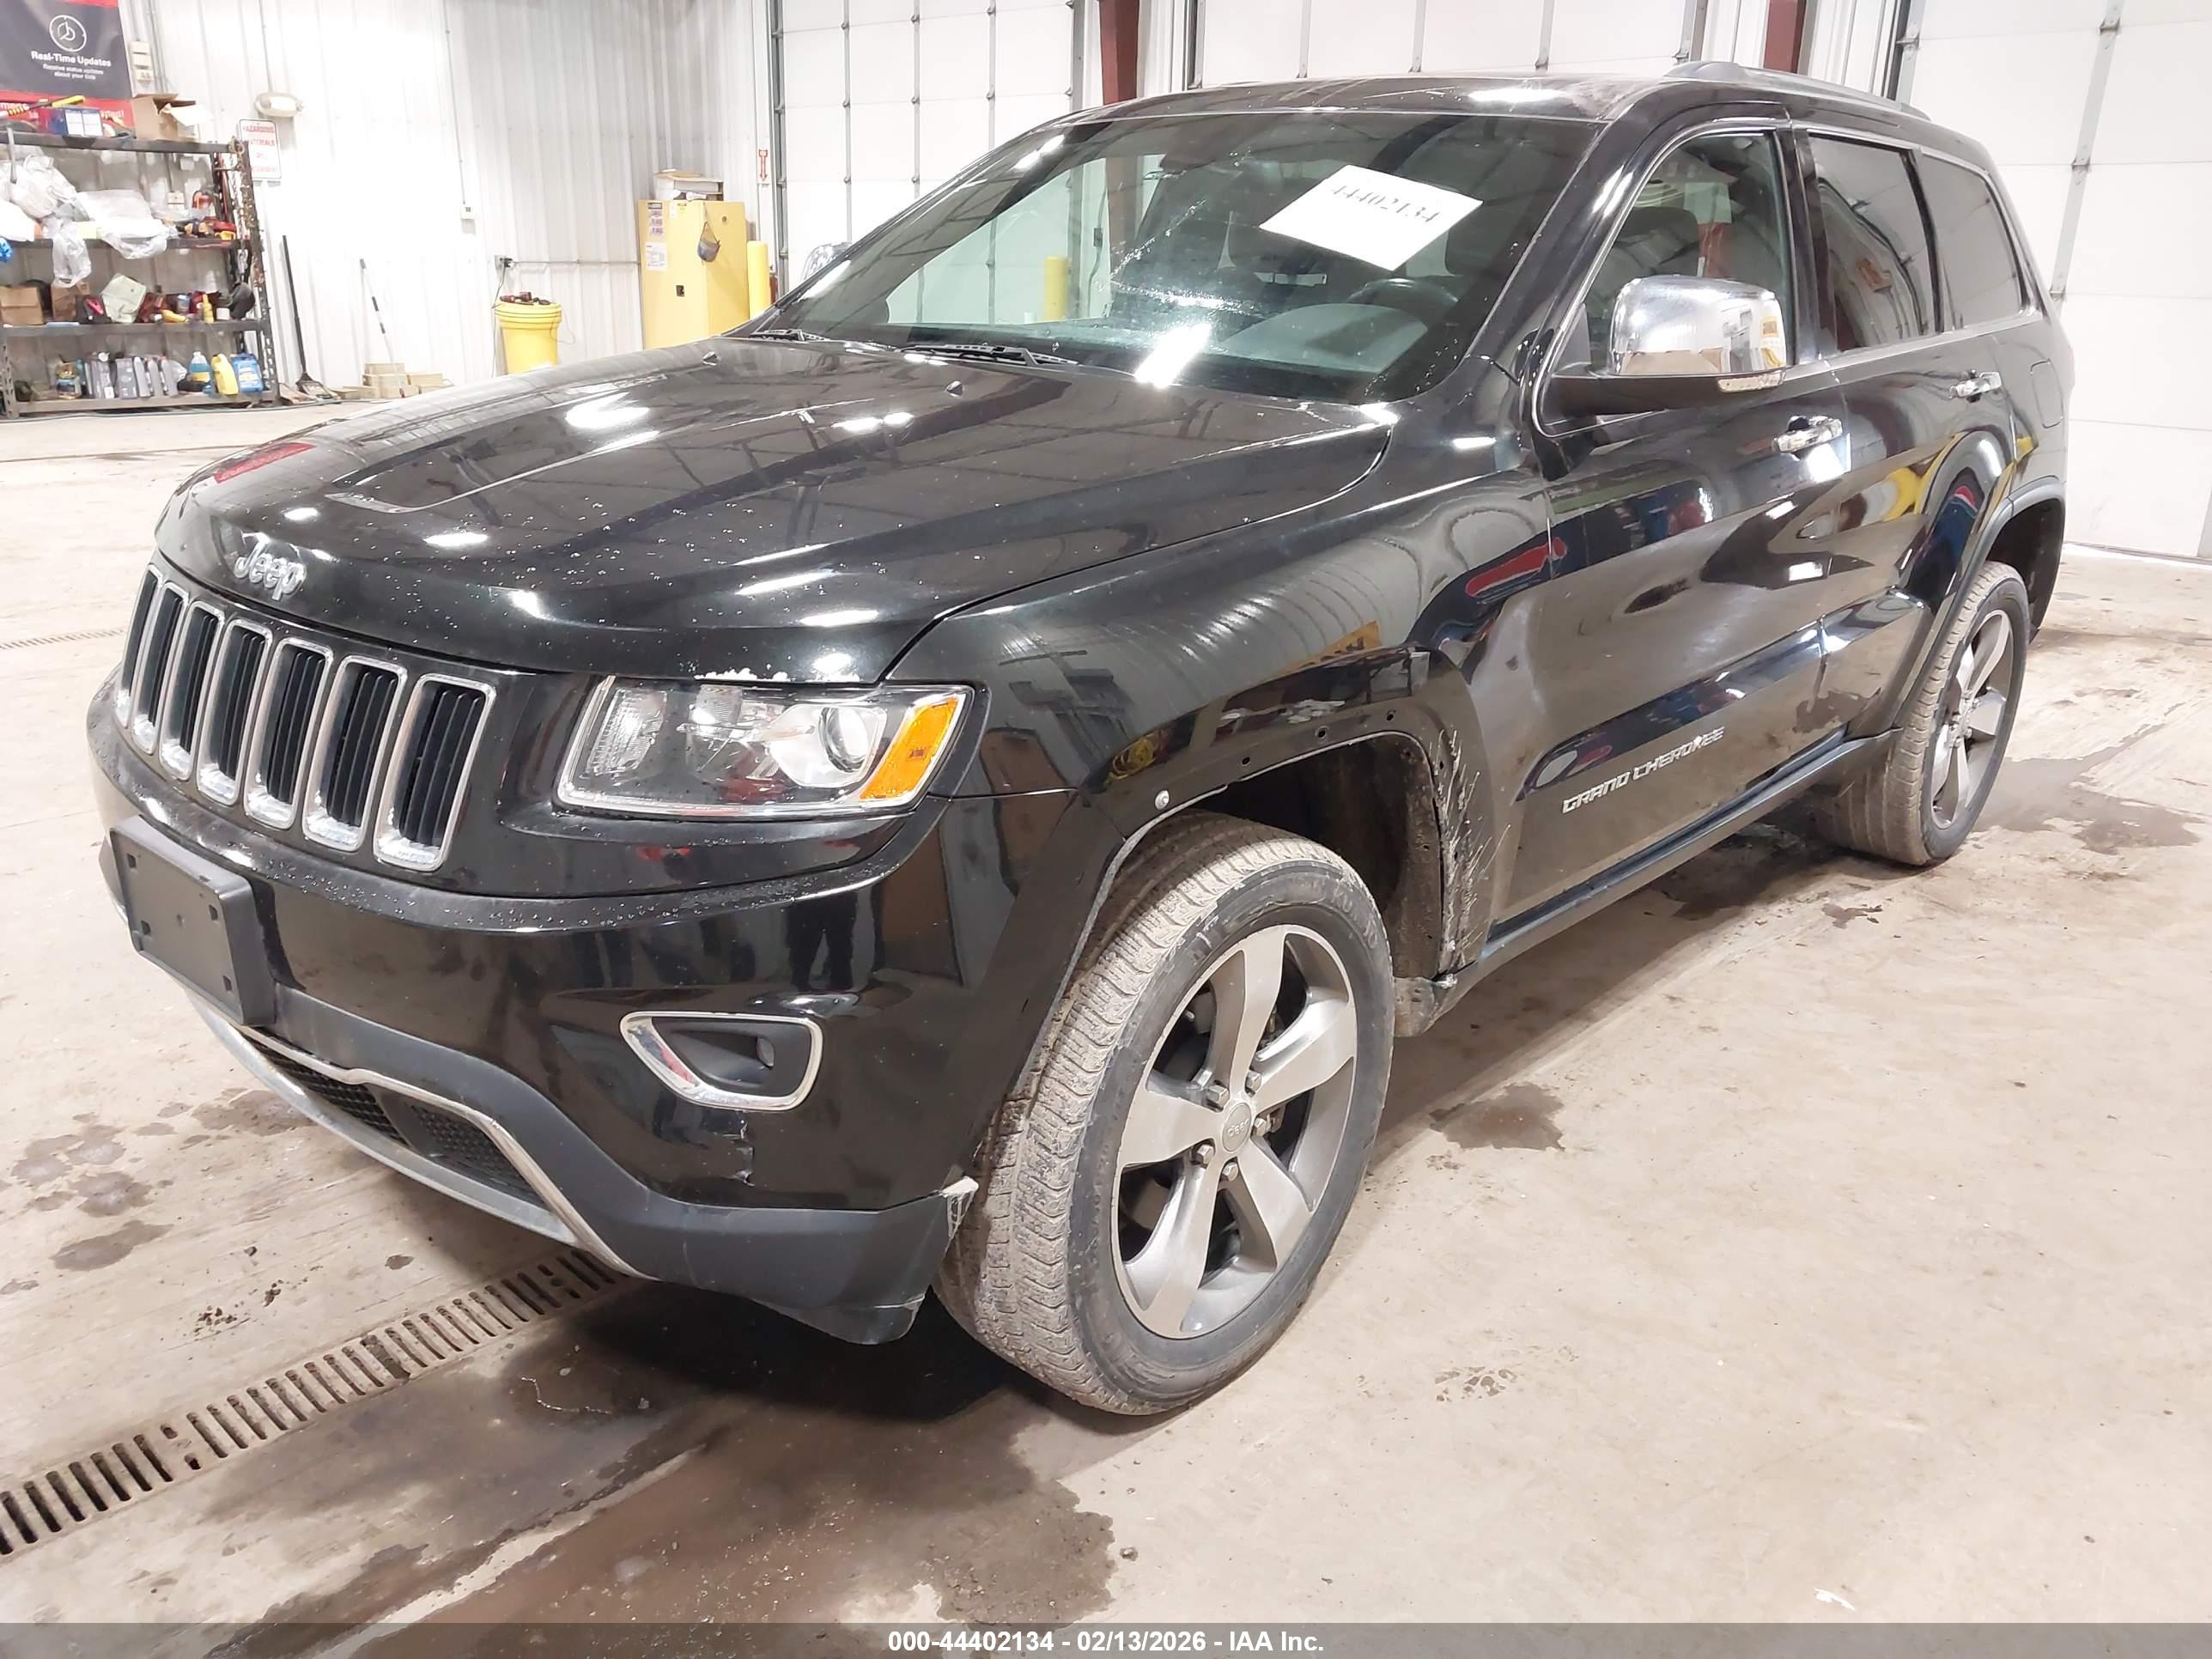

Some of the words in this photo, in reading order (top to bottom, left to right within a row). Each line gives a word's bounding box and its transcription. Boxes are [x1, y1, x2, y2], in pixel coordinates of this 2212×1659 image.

[30, 50, 76, 64] Real-Time
[76, 56, 112, 68] Updates
[234, 532, 307, 601] Jeep
[1561, 771, 1632, 815] GRAND
[1632, 725, 1726, 781] CHEROKEE
